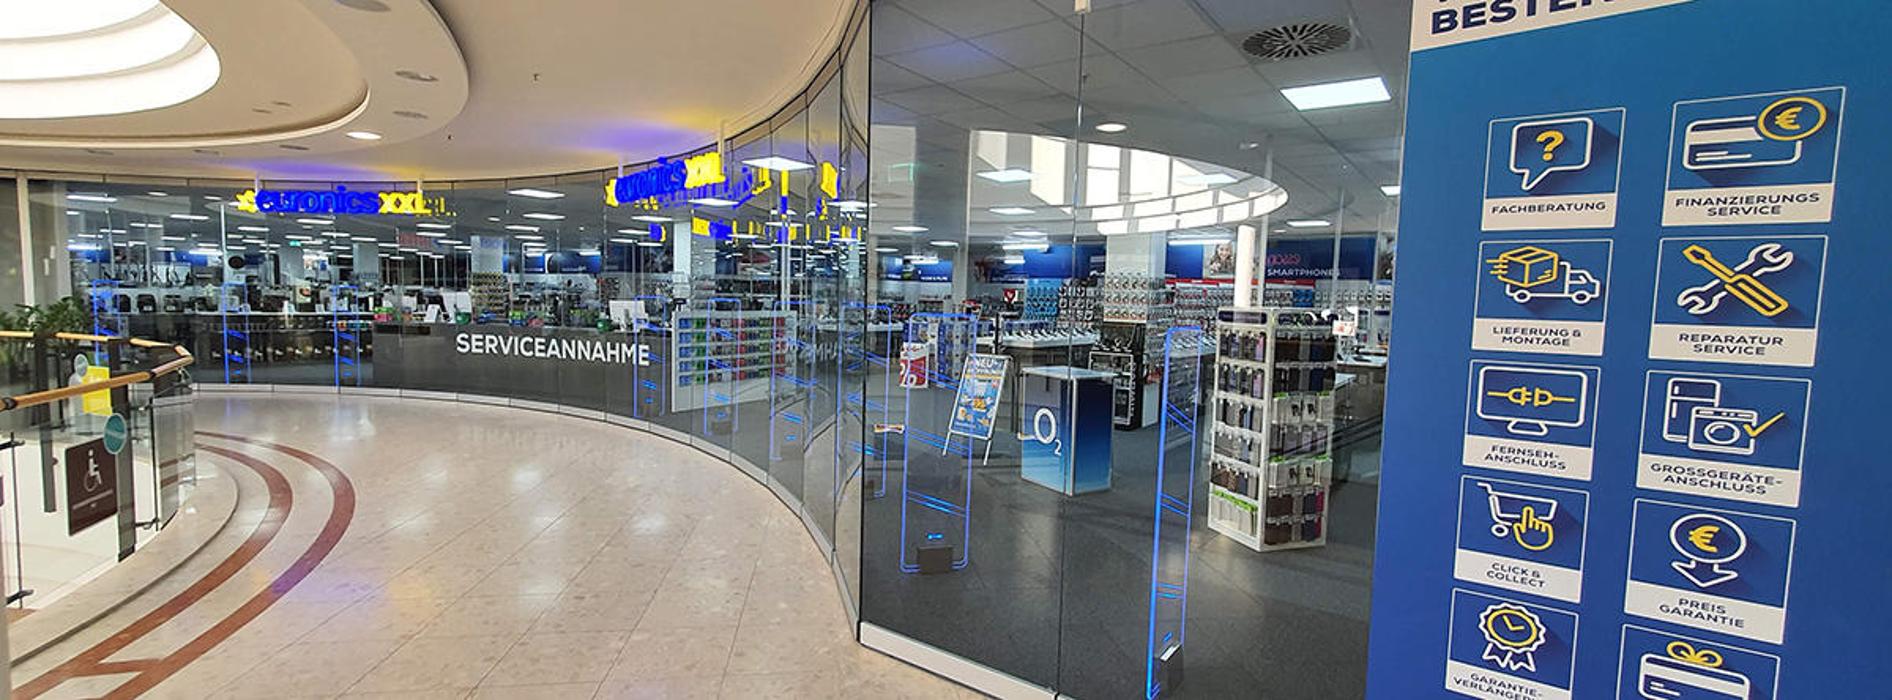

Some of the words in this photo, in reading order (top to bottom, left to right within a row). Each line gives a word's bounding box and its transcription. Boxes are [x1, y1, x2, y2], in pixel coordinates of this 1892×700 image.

[1491, 201, 1606, 214] FACHBERATUNG
[1675, 193, 1820, 207] FINANZIERUNGS
[1707, 205, 1781, 216] SERVICE
[1492, 326, 1570, 337] LIEFERUNG
[1679, 333, 1784, 346] REPARATUR
[456, 333, 650, 366] SERVICEANNAHME
[1501, 336, 1571, 347] MONTAGE
[1693, 344, 1766, 356] SERVICE
[1491, 445, 1560, 459] FERNSEH-
[1484, 453, 1567, 471] ANSCHLUSS
[1650, 463, 1784, 485] GROSSGERÄTE-
[1663, 475, 1767, 495] ANSCHLUSS
[1486, 570, 1546, 588] COLLECT
[1491, 562, 1532, 579] CLICK
[1679, 597, 1727, 614] PREIS
[1659, 604, 1745, 628] GARANTIE
[1469, 672, 1543, 697] GARANTIE-
